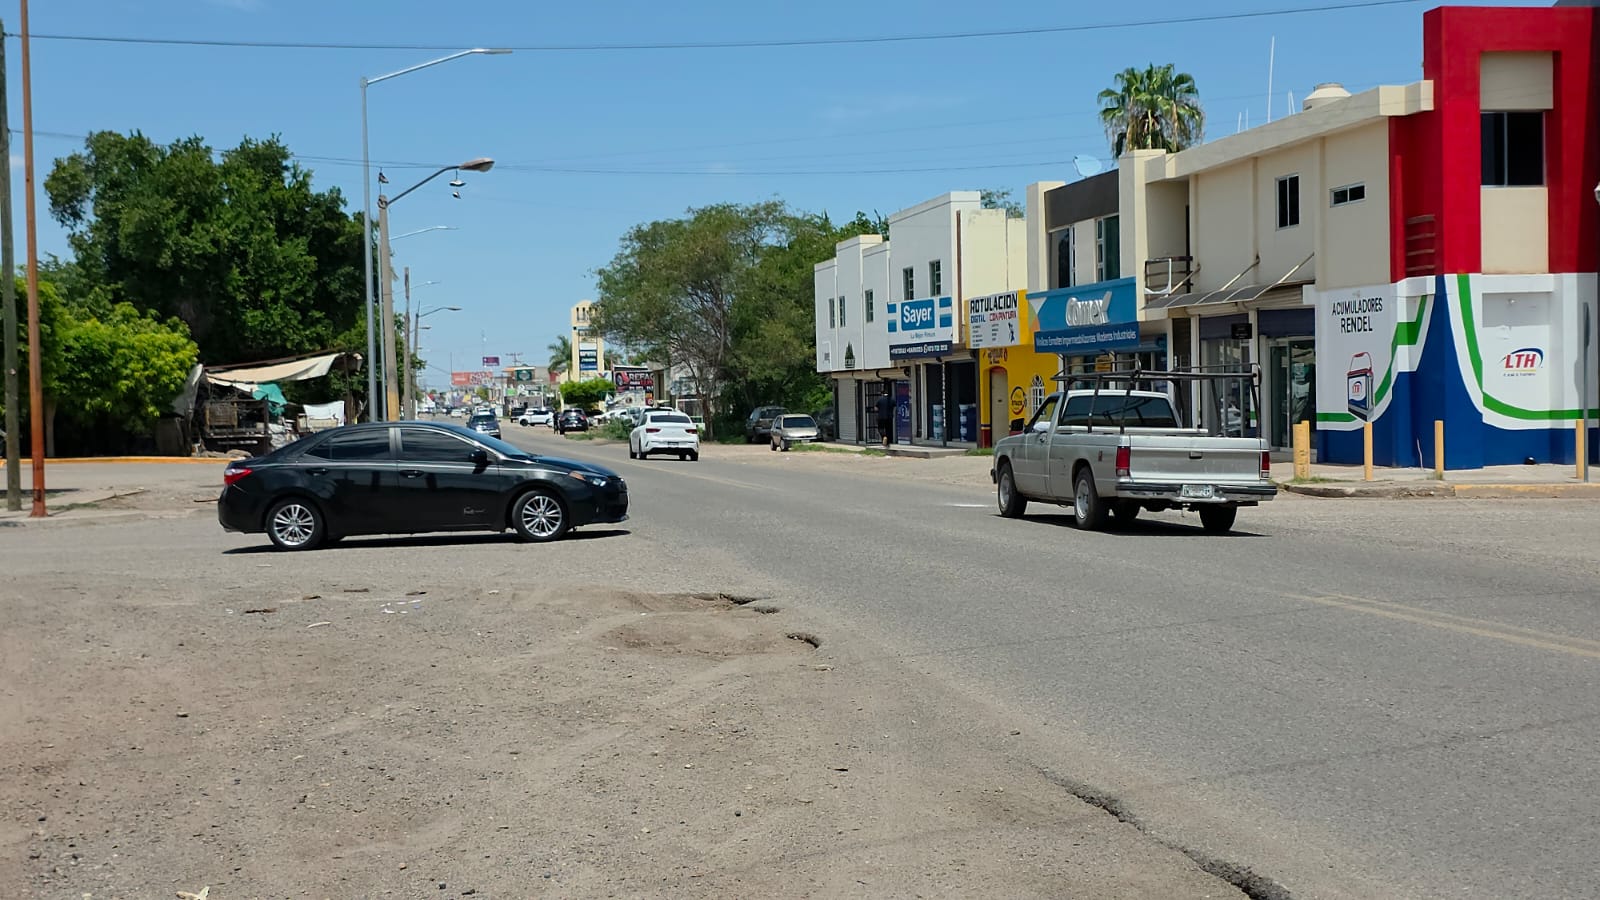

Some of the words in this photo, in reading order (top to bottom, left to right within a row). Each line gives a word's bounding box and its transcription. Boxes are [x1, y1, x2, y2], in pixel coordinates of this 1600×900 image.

[970, 293, 1018, 314] ROTULACION
[1066, 291, 1112, 326] Comex
[1332, 297, 1383, 316] ACUMULADORES
[903, 305, 932, 326] Sayer
[1340, 316, 1373, 334] RENDEL
[1505, 353, 1537, 369] LTH
